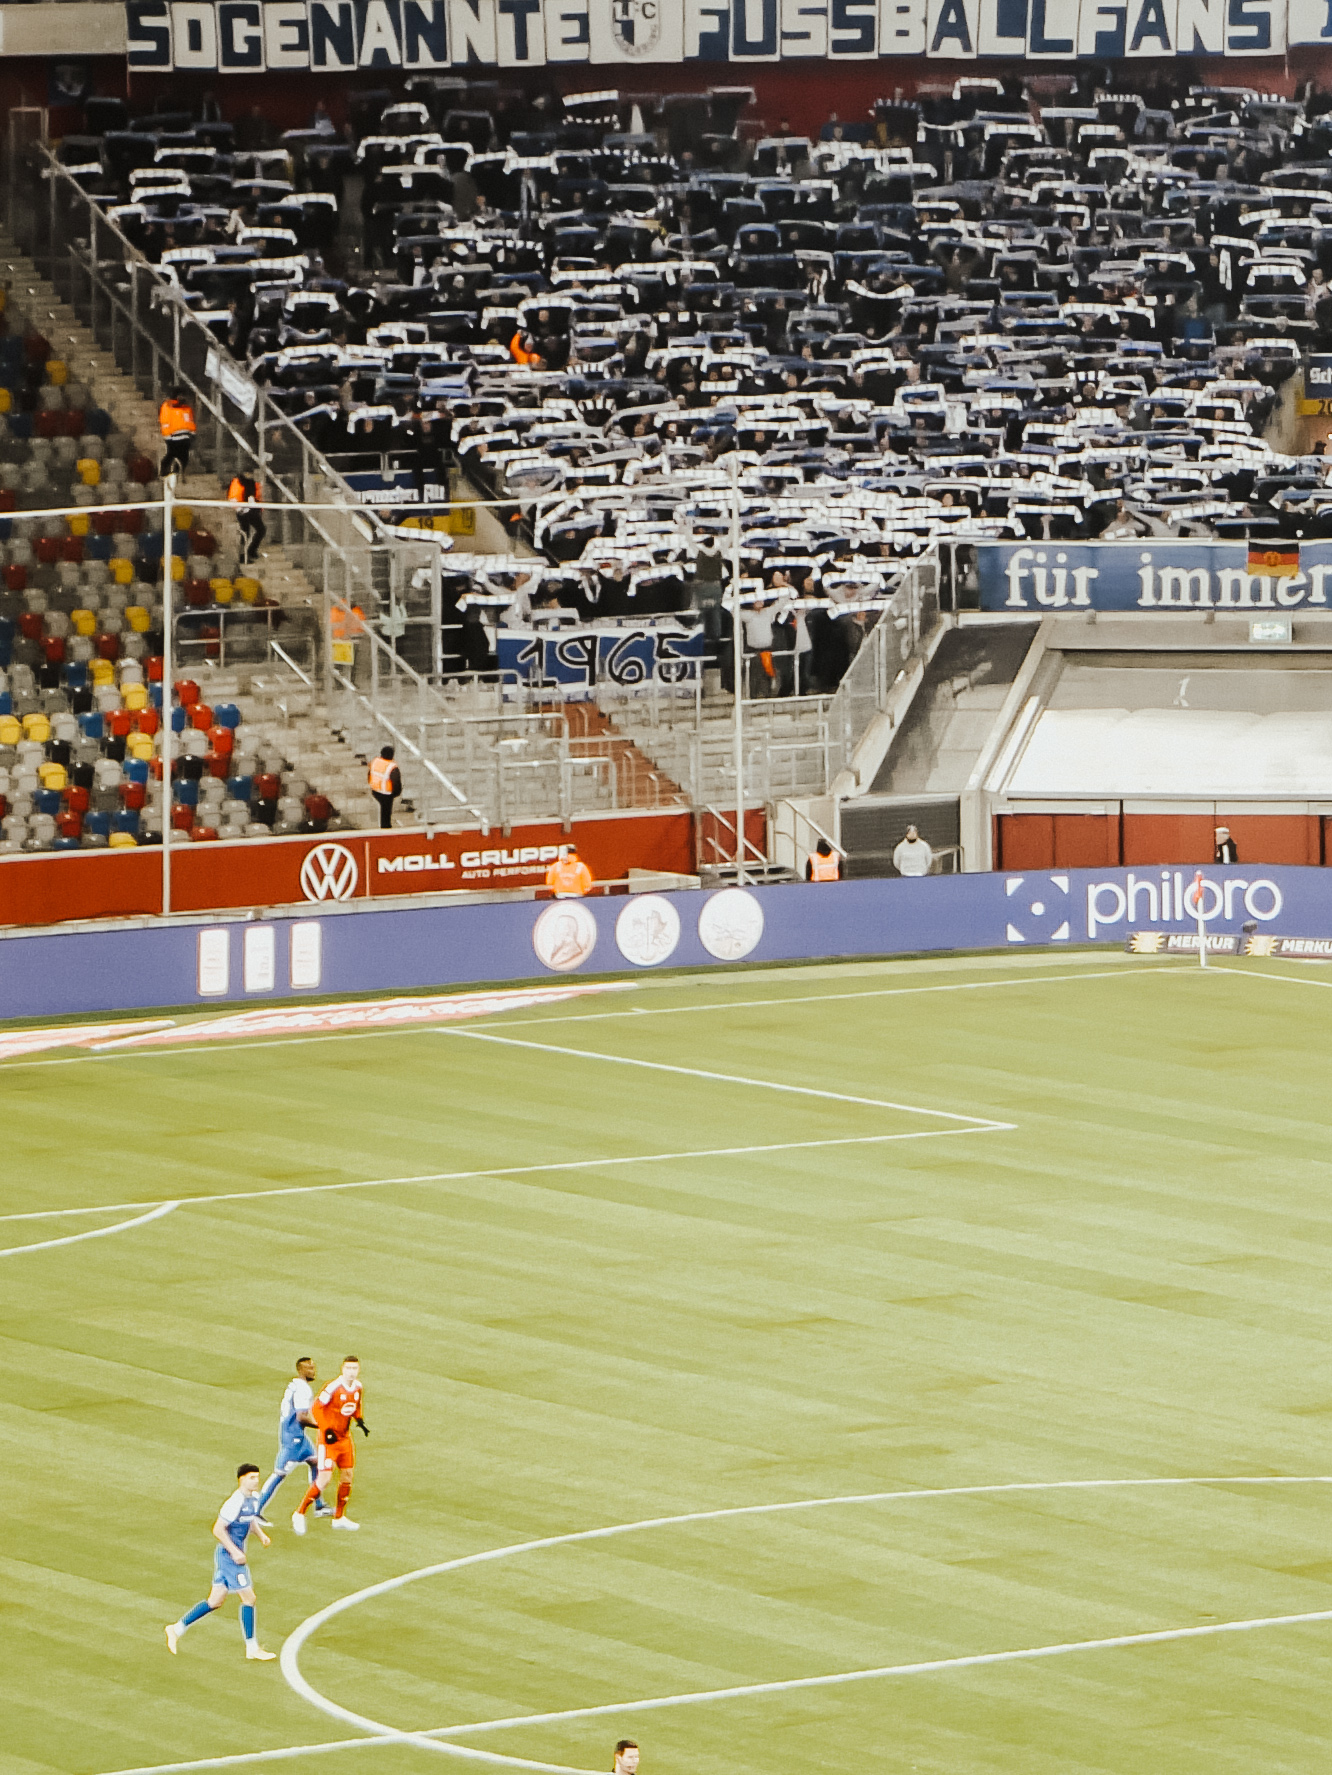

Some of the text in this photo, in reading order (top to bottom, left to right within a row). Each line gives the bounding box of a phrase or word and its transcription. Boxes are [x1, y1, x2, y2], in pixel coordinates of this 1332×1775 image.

[1004, 548, 1099, 608] für
[517, 631, 690, 687] 1965
[378, 853, 455, 873] MOLL
[1087, 871, 1283, 939] philoro
[1168, 935, 1235, 951] MERKUR
